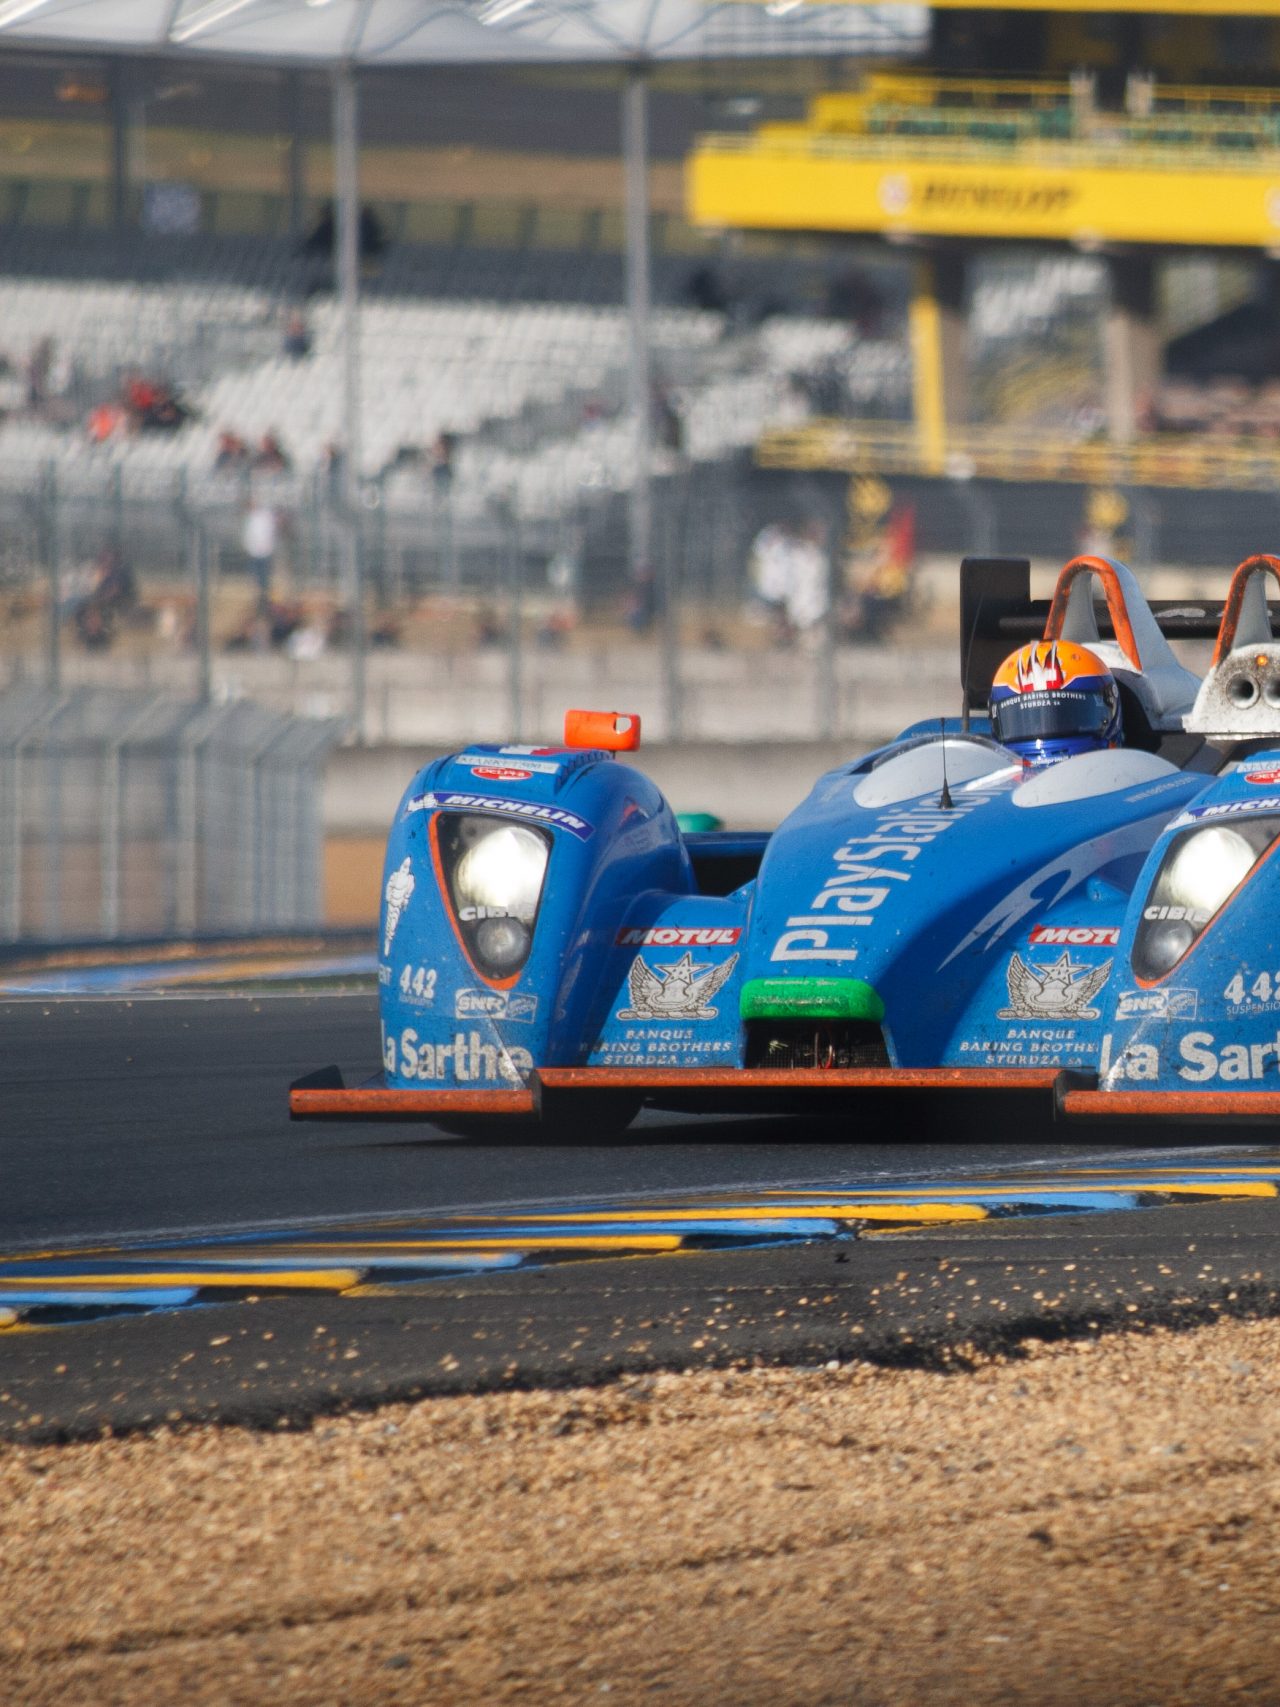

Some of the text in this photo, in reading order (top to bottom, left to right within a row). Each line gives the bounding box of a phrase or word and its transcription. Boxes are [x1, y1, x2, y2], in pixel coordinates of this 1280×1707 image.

[444, 794, 587, 830] MICHELIN
[621, 928, 735, 945] MOTUL
[1035, 928, 1119, 944] MOT
[400, 964, 437, 999] 4.42
[458, 996, 502, 1011] SNR
[626, 1030, 694, 1040] BANQUE
[1007, 1029, 1076, 1041] BANQUE
[648, 1042, 732, 1052] BROTHERS
[960, 1042, 1024, 1052] BARING
[401, 1028, 534, 1081] Sarthe
[604, 1054, 677, 1065] STURDZA
[985, 1055, 1061, 1065] STURDZA
